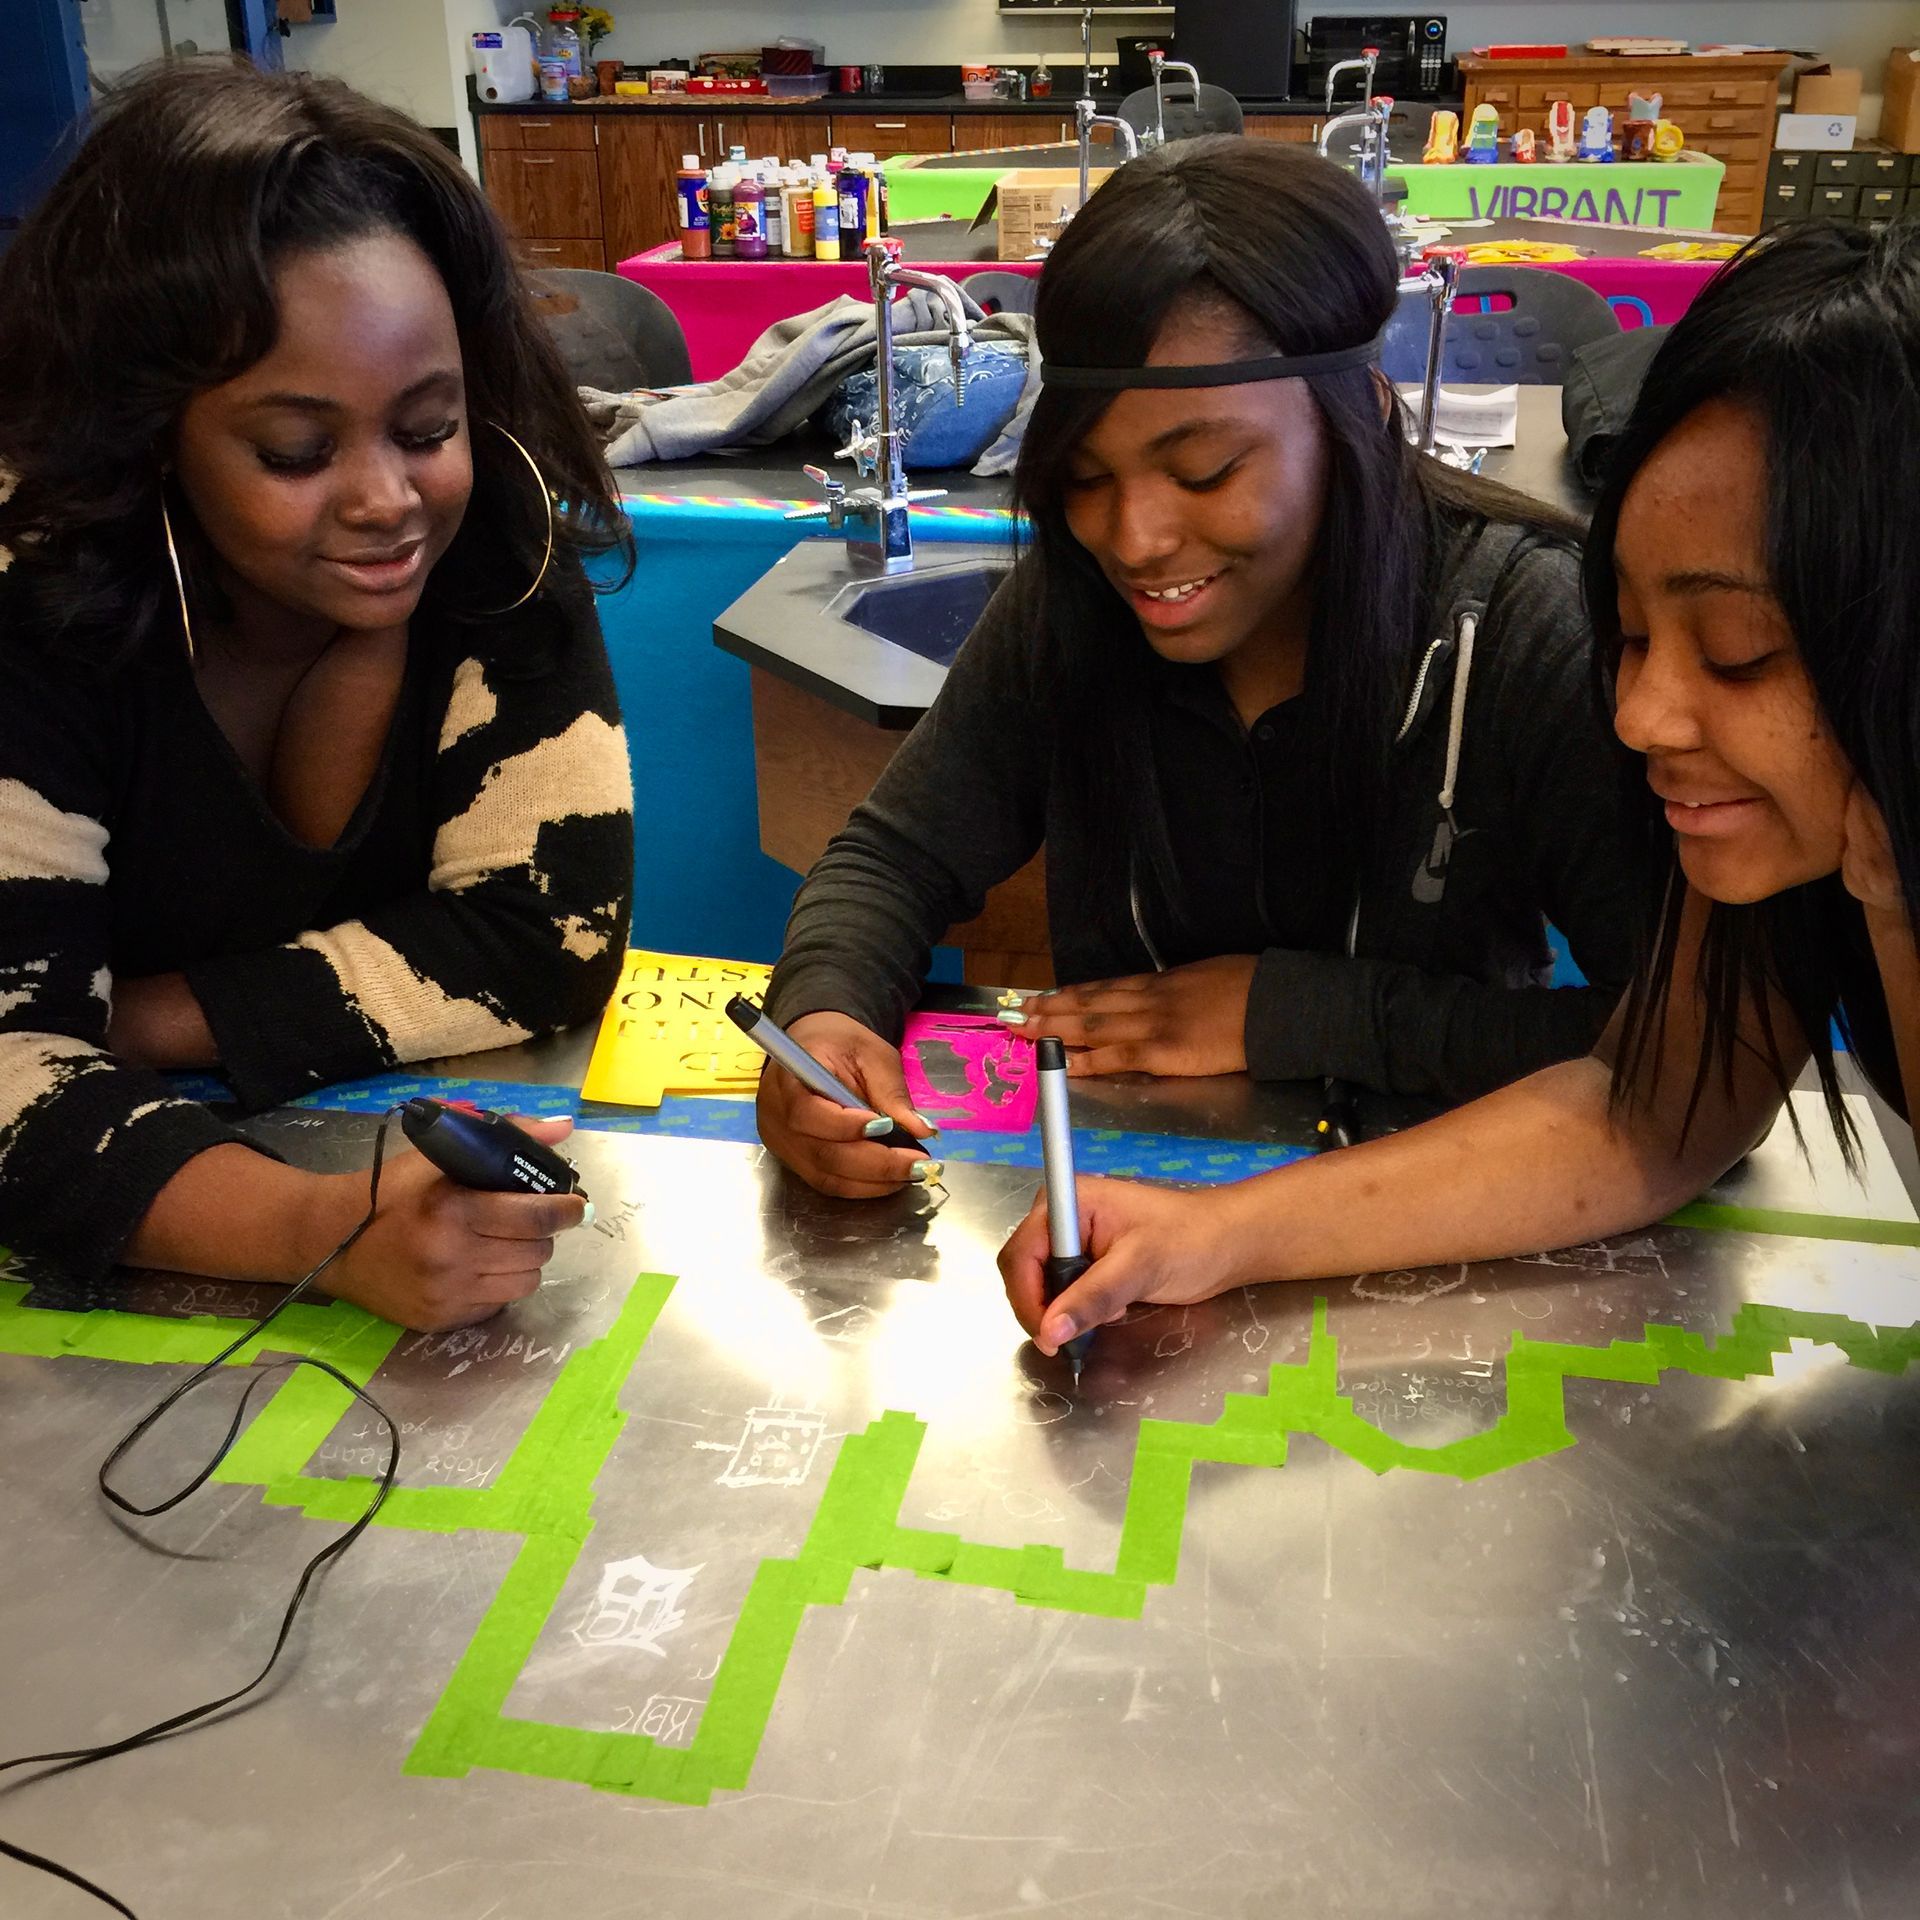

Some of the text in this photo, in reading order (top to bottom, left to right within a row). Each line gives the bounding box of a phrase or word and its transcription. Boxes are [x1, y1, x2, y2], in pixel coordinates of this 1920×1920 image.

[1469, 185, 1682, 228] VIBRANT
[514, 1154, 539, 1176] VOLTAGE
[546, 1178, 557, 1189] DC
